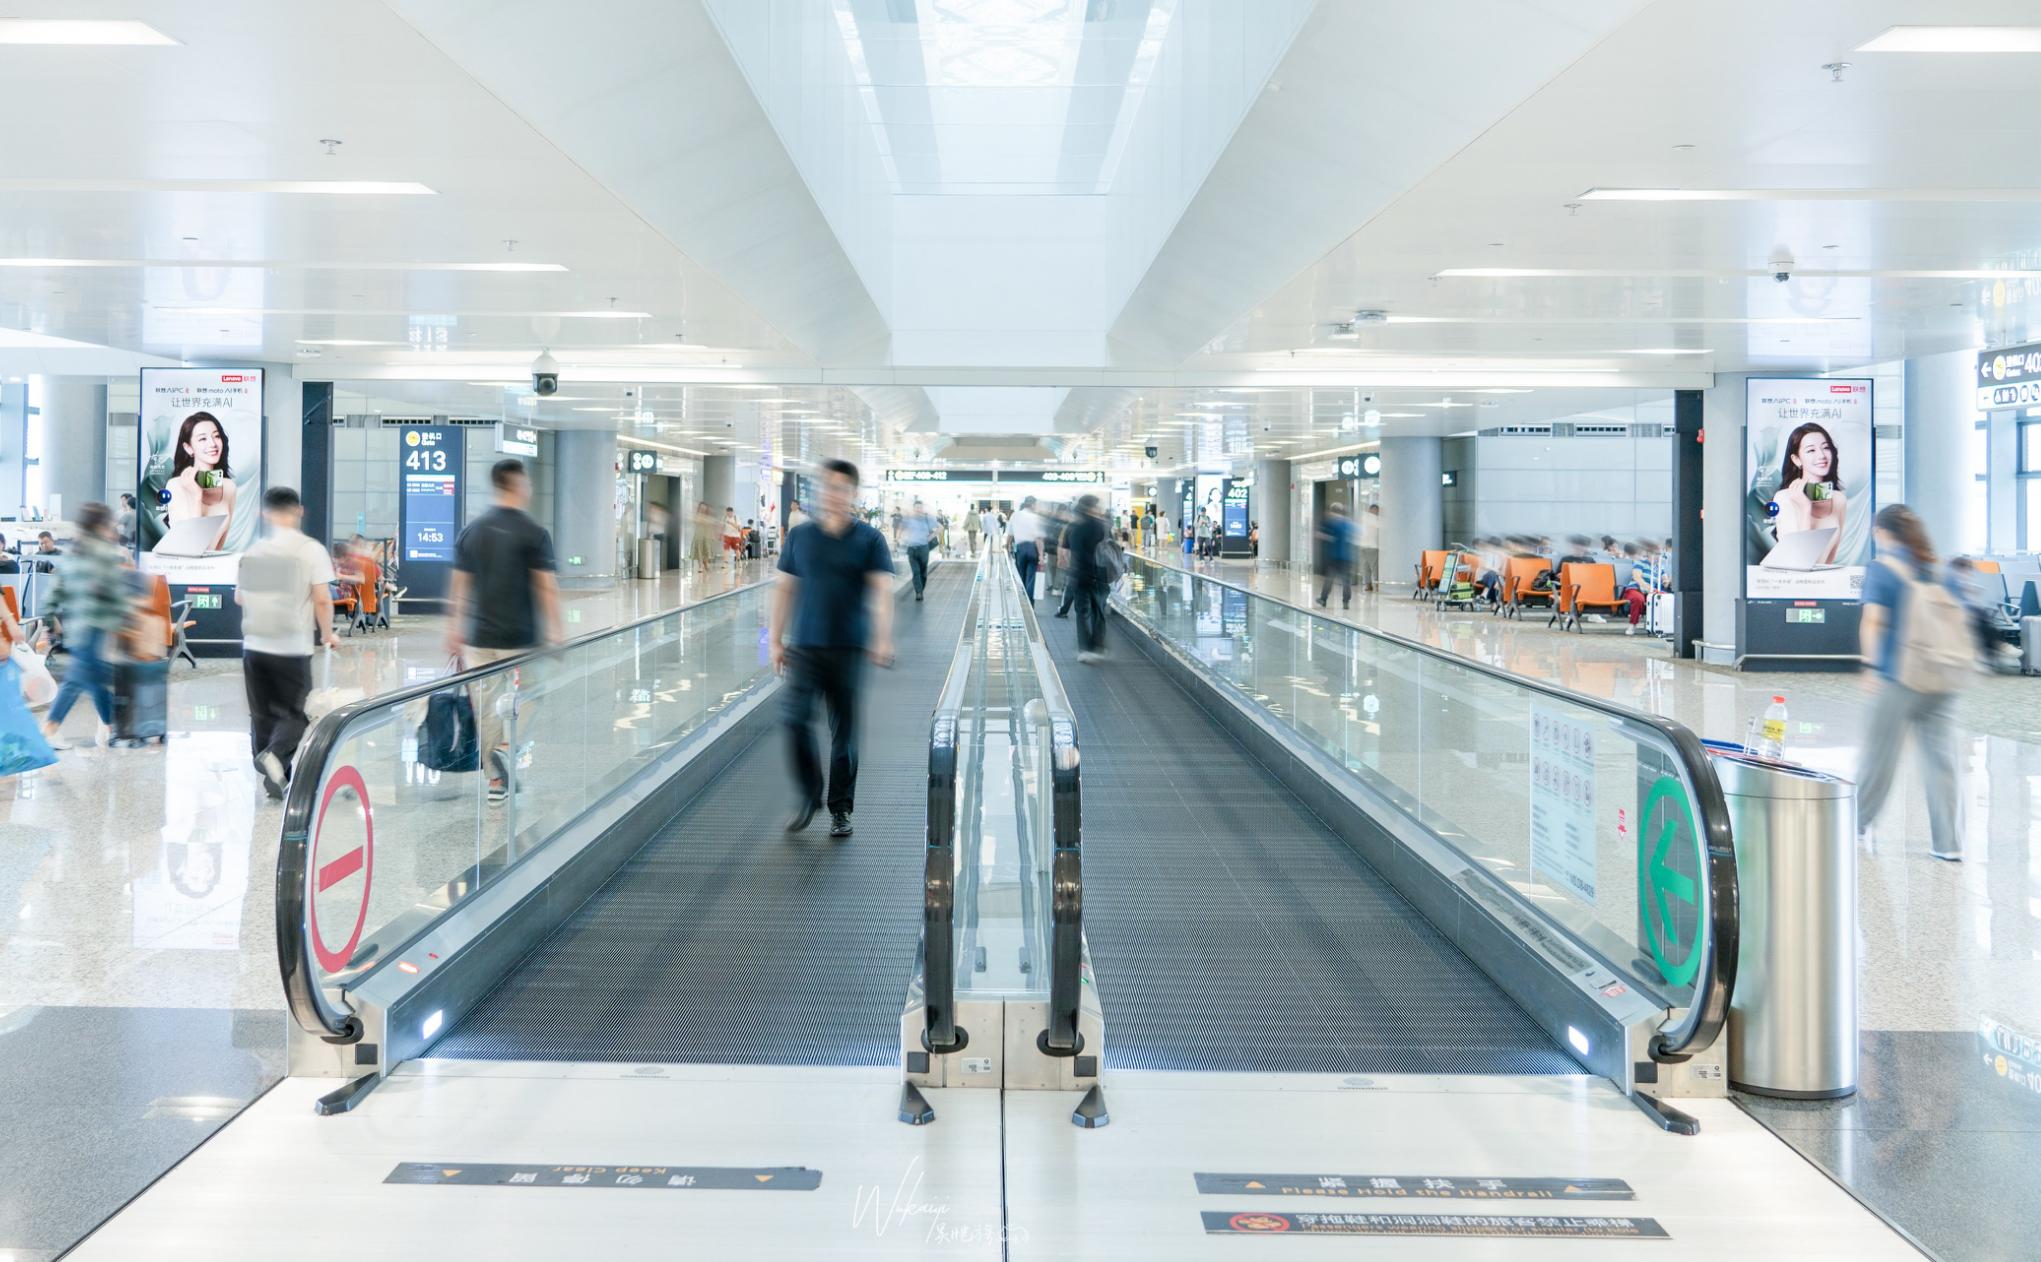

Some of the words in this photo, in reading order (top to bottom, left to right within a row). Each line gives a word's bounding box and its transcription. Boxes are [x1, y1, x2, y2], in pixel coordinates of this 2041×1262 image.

[2024, 351, 2041, 374] 40
[171, 397, 233, 408] 让世界充满AI
[1778, 407, 1842, 419] 让世界充满AI
[406, 450, 447, 471] 413
[1227, 487, 1248, 498] 402
[417, 532, 444, 543] 14:53
[552, 1166, 606, 1174] Clear
[615, 1167, 667, 1175] Keep
[508, 1172, 696, 1187] 请勿停留
[1318, 1176, 1508, 1190] 紧握扶手
[1281, 1186, 1348, 1196] Please
[1357, 1187, 1407, 1196] Hold
[1416, 1188, 1451, 1197] the
[1459, 1189, 1553, 1198] Handrail
